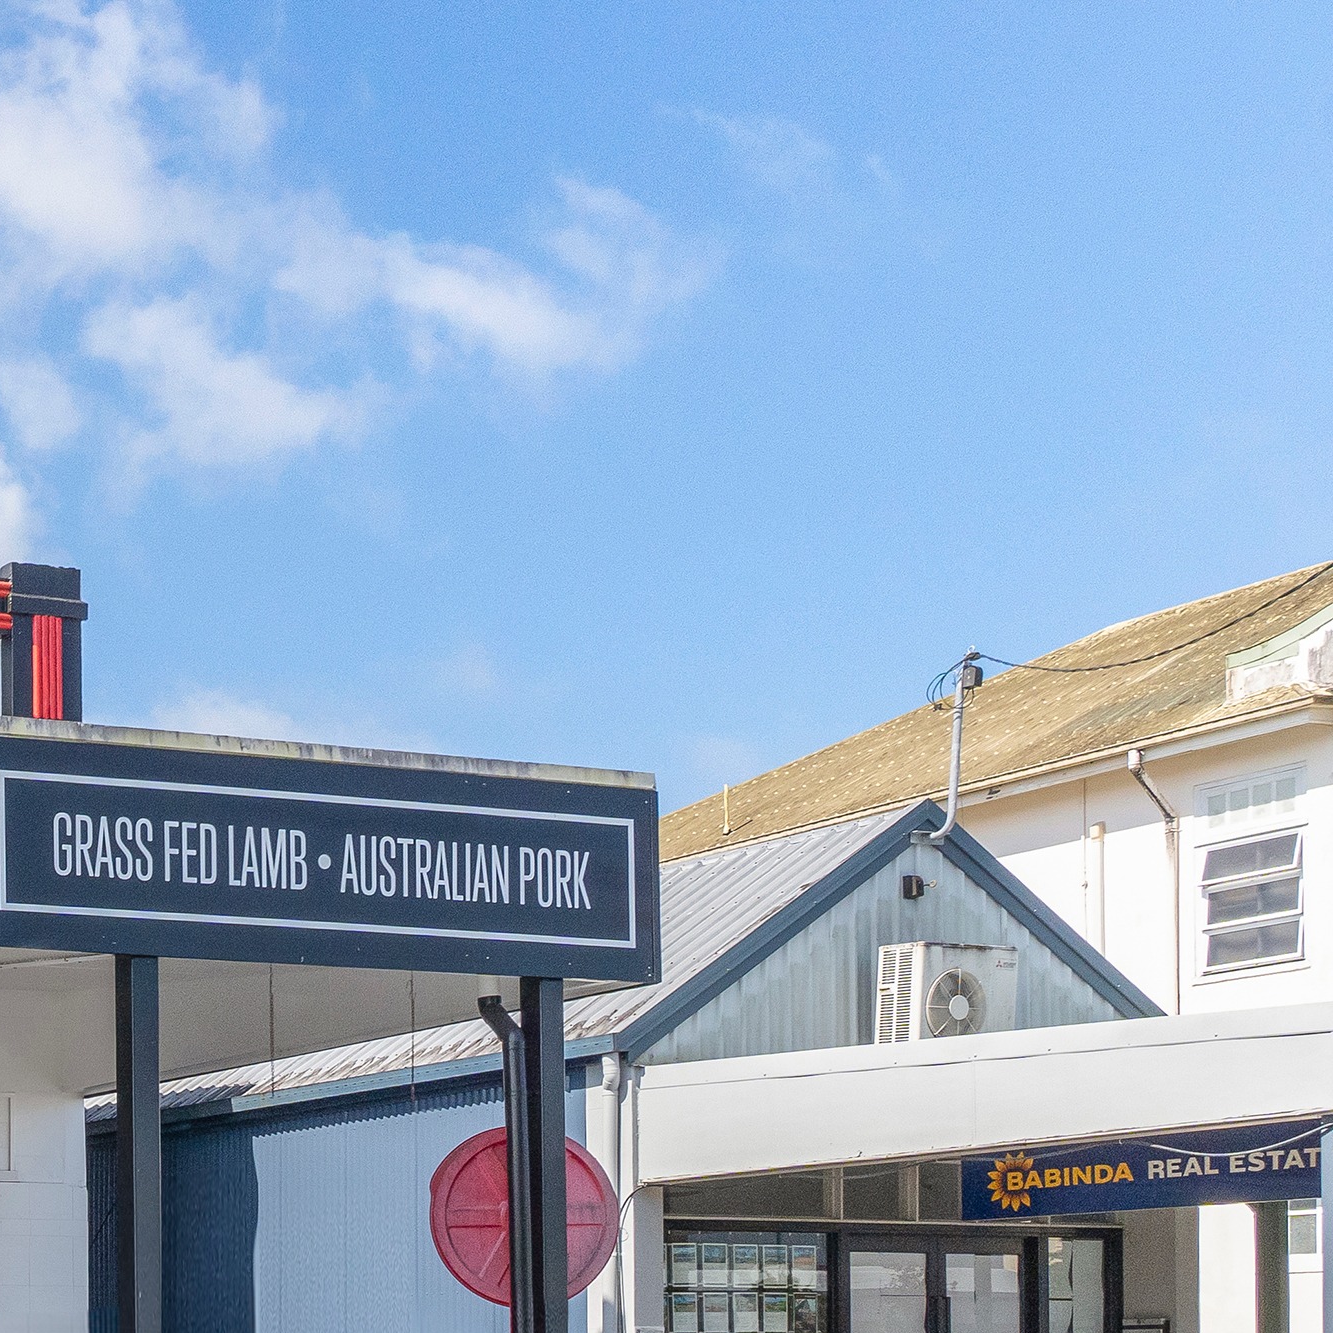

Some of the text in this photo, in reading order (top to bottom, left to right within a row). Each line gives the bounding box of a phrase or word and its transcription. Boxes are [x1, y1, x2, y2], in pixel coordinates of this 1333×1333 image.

[52, 811, 592, 910] GRASS FED LAMB AUSTRALIAN PORK
[1005, 1147, 1321, 1192] BABINDA REAL ESTAT
